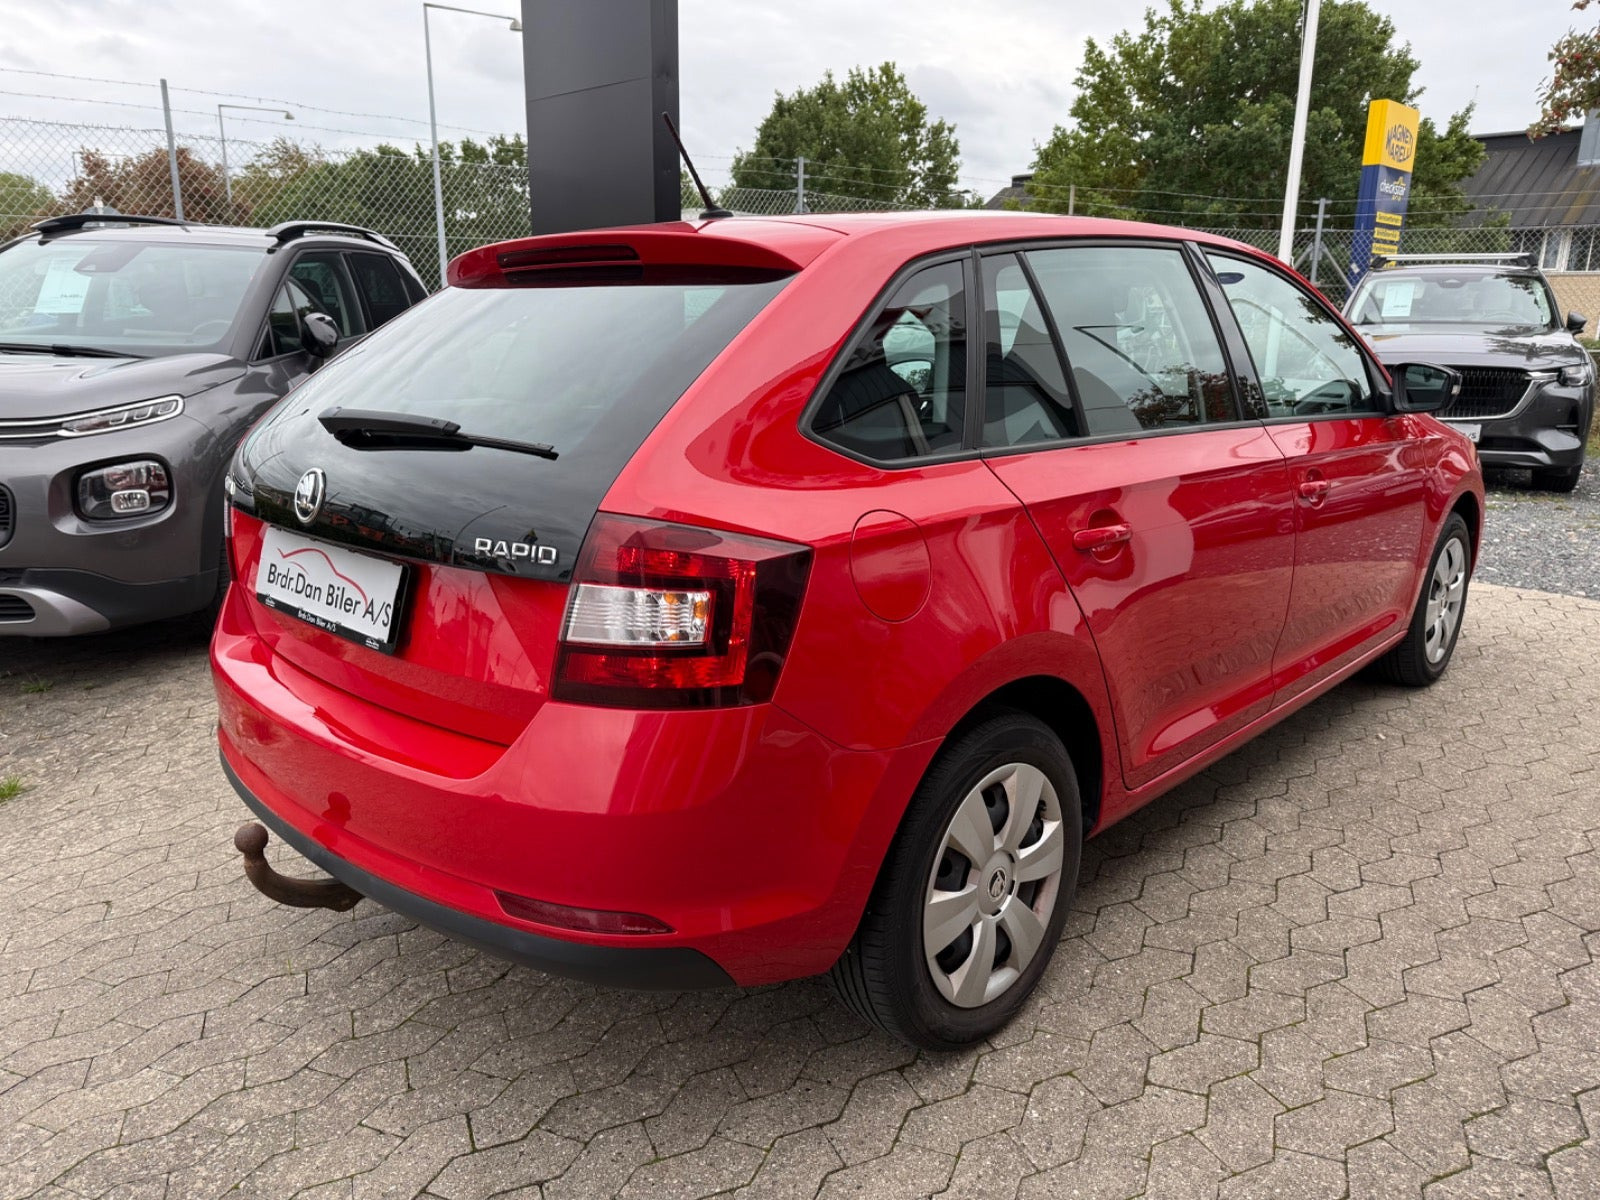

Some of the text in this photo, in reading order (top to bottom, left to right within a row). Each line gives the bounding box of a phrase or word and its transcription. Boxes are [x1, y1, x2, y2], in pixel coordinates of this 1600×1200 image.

[1387, 124, 1413, 144] MAGNETI
[1386, 140, 1412, 162] MARELLI
[1380, 180, 1406, 196] checkstar
[475, 537, 557, 564] RAPID
[267, 563, 392, 627] Brdr.Dan Biler A/S
[316, 617, 327, 628] Biler
[327, 622, 336, 632] A/S
